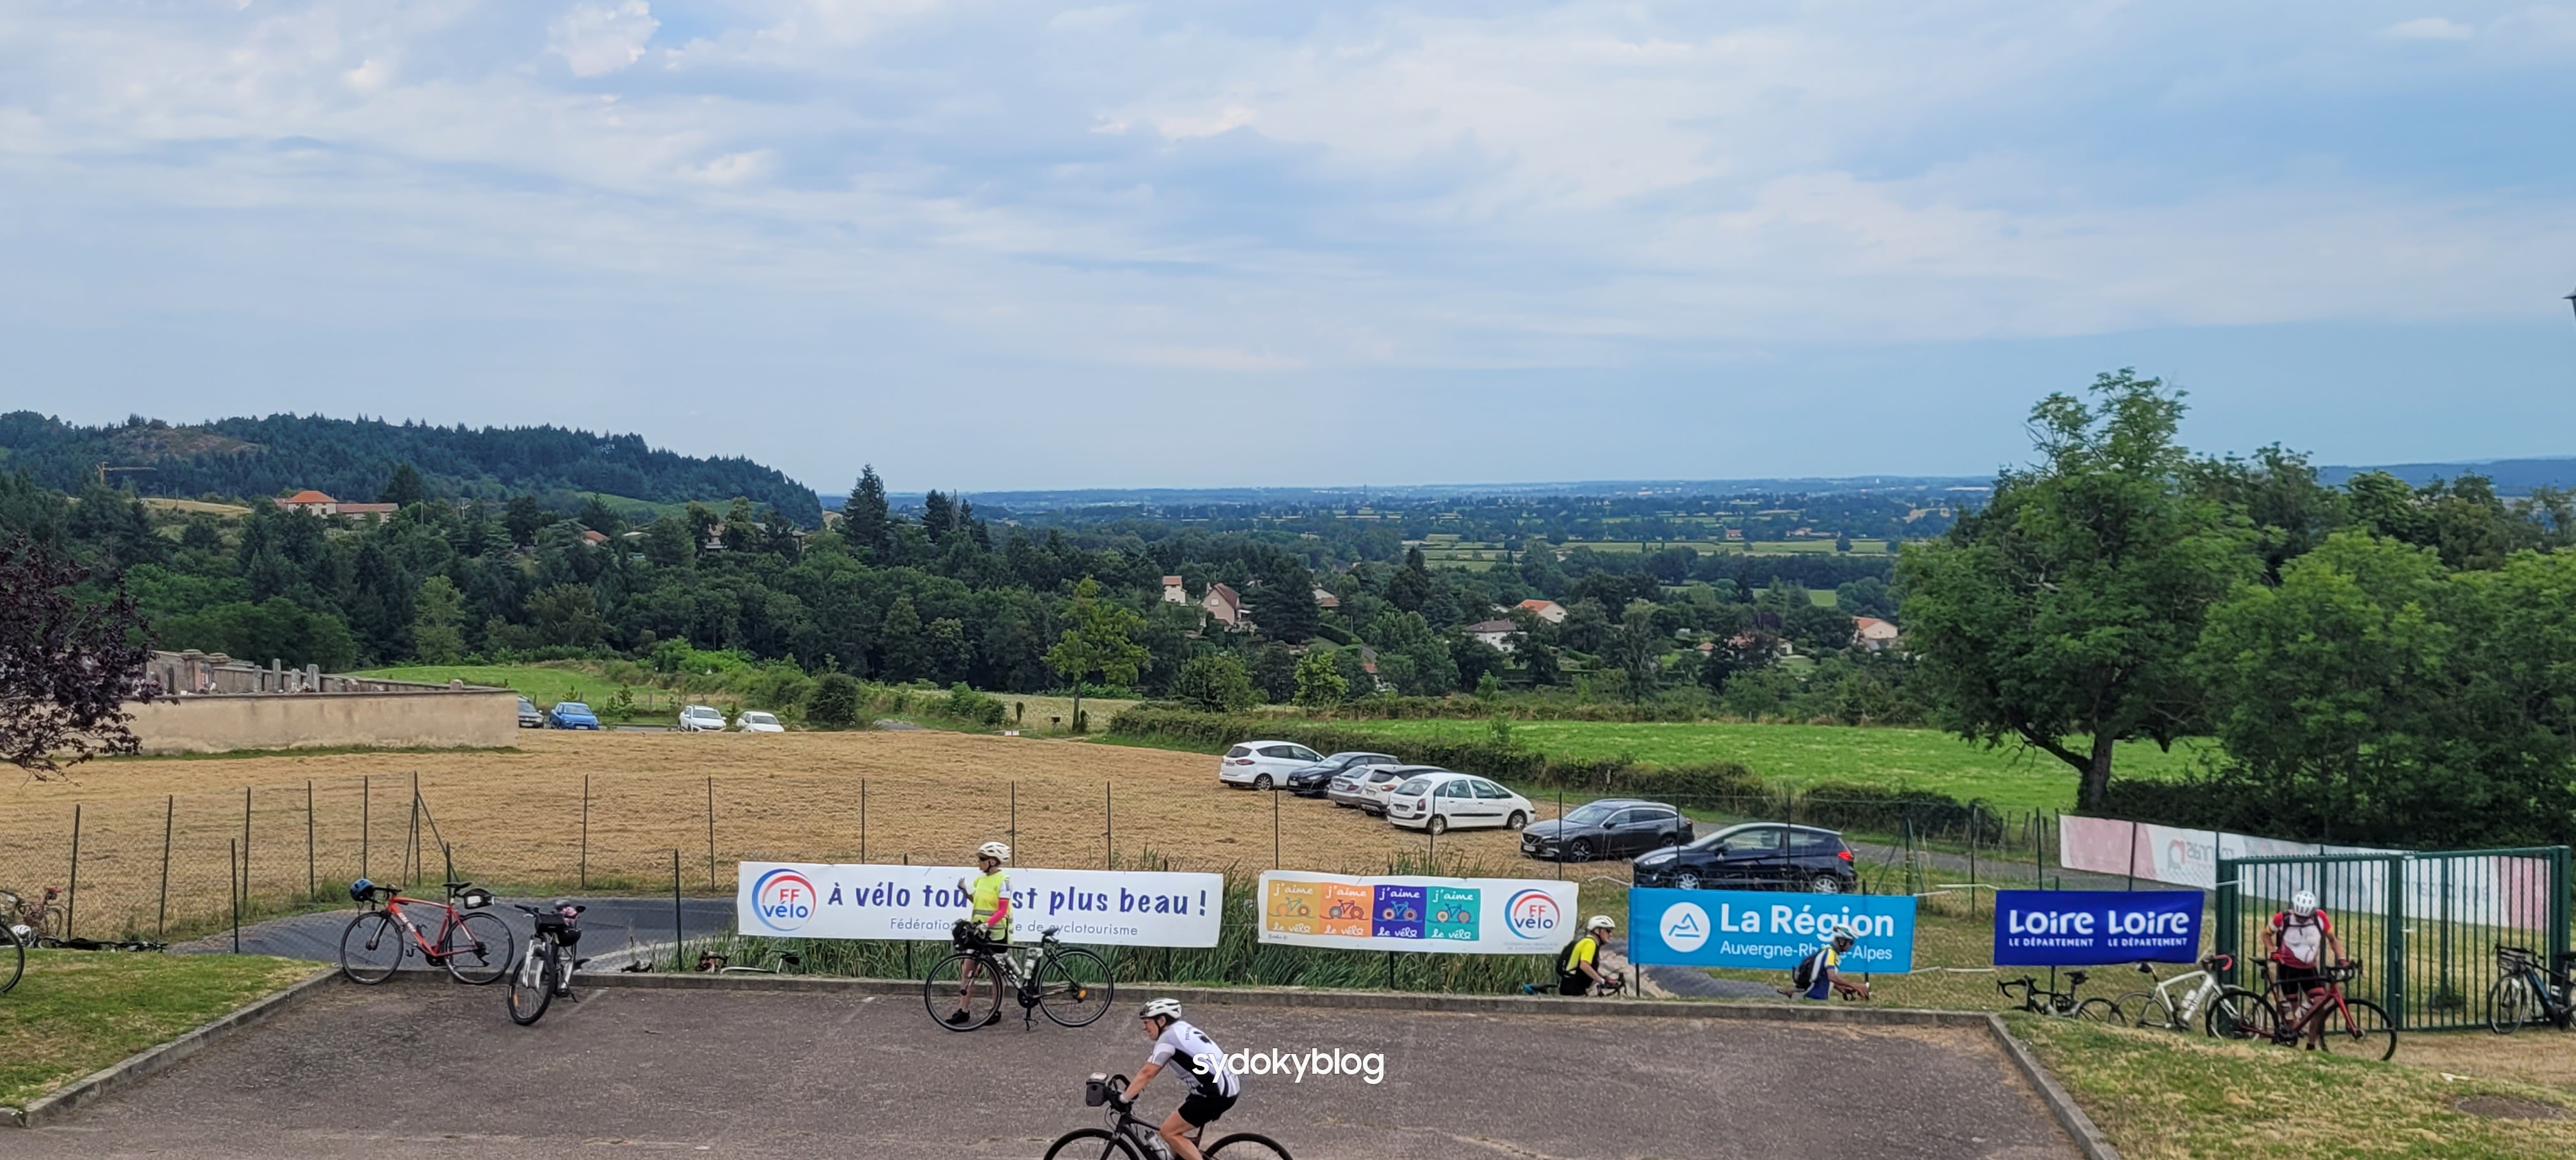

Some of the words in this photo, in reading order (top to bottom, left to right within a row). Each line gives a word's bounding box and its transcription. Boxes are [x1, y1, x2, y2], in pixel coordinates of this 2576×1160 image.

[779, 889, 801, 903] FF
[1273, 883, 1314, 896] j'aime
[1326, 885, 1367, 899] j'aime
[1379, 887, 1421, 901] j'aime
[1432, 889, 1475, 903] j'aime
[828, 882, 843, 905] À
[855, 881, 910, 908] vélo
[923, 885, 967, 908] tou
[1011, 887, 1038, 909] st
[1048, 886, 1108, 915] plus
[1119, 887, 1188, 915] beau
[1199, 890, 1206, 916] !
[762, 900, 808, 918] vélo
[1529, 904, 1547, 917] FF
[891, 917, 952, 929] Fédératio
[1028, 920, 1043, 931] de
[1289, 923, 1311, 933] vélo
[1514, 914, 1553, 929] vélo
[1721, 903, 1761, 933] La
[1770, 904, 1894, 942] Région
[2009, 910, 2094, 935] Loire
[2108, 910, 2189, 935] Loire
[1341, 925, 1363, 936] vélo
[1377, 926, 1391, 936] le
[1395, 927, 1417, 938] vélo
[1431, 928, 1445, 938] le
[1448, 929, 1471, 939] vélo
[2009, 938, 2020, 947] LE
[2023, 936, 2094, 947] DÉPARTEMENT
[2108, 938, 2118, 947] LE
[2121, 936, 2187, 947] DÉPARTEMENT
